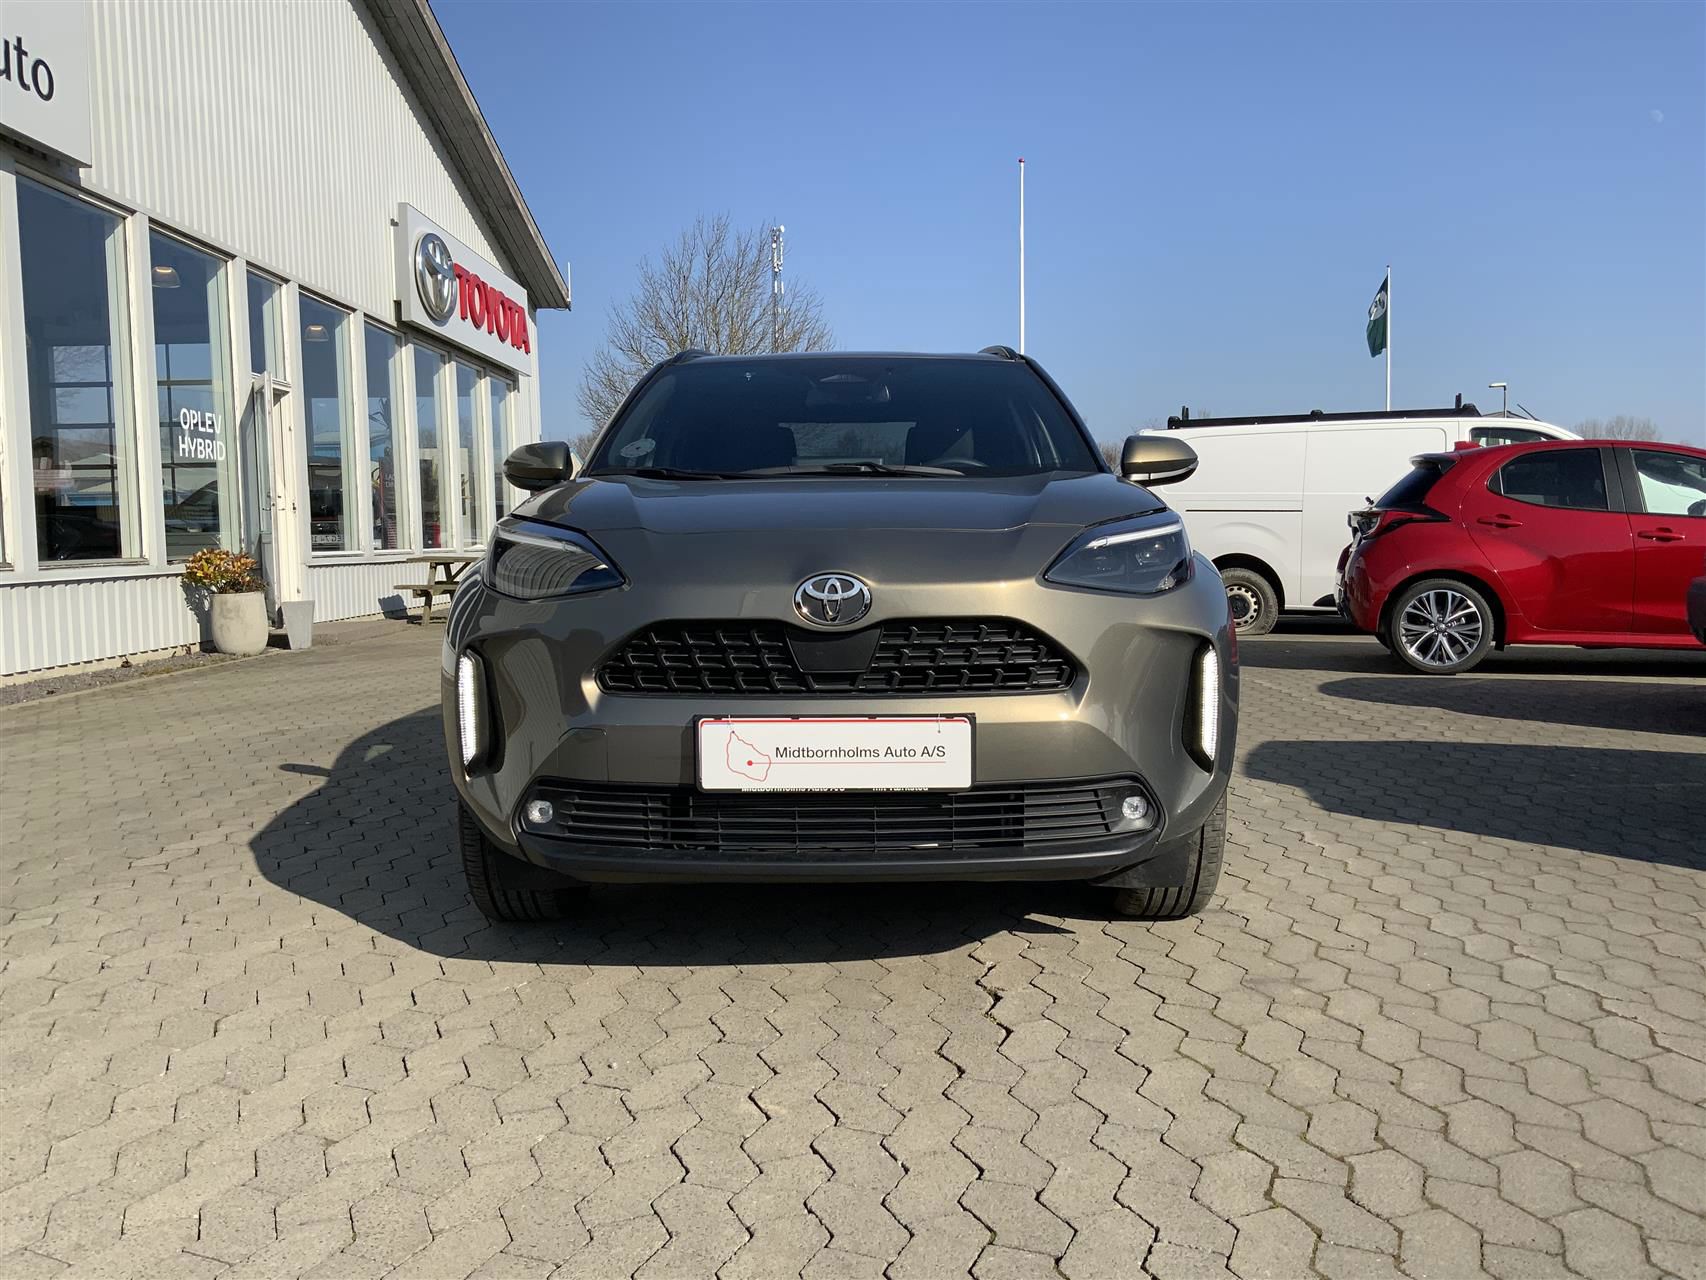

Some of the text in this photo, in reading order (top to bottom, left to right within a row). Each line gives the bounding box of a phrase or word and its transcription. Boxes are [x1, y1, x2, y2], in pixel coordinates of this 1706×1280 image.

[453, 262, 531, 355] TOYOTA
[180, 407, 222, 435] OPLEV
[178, 435, 227, 461] HYBRID
[775, 745, 946, 758] Midtbornholms Auto A/S
